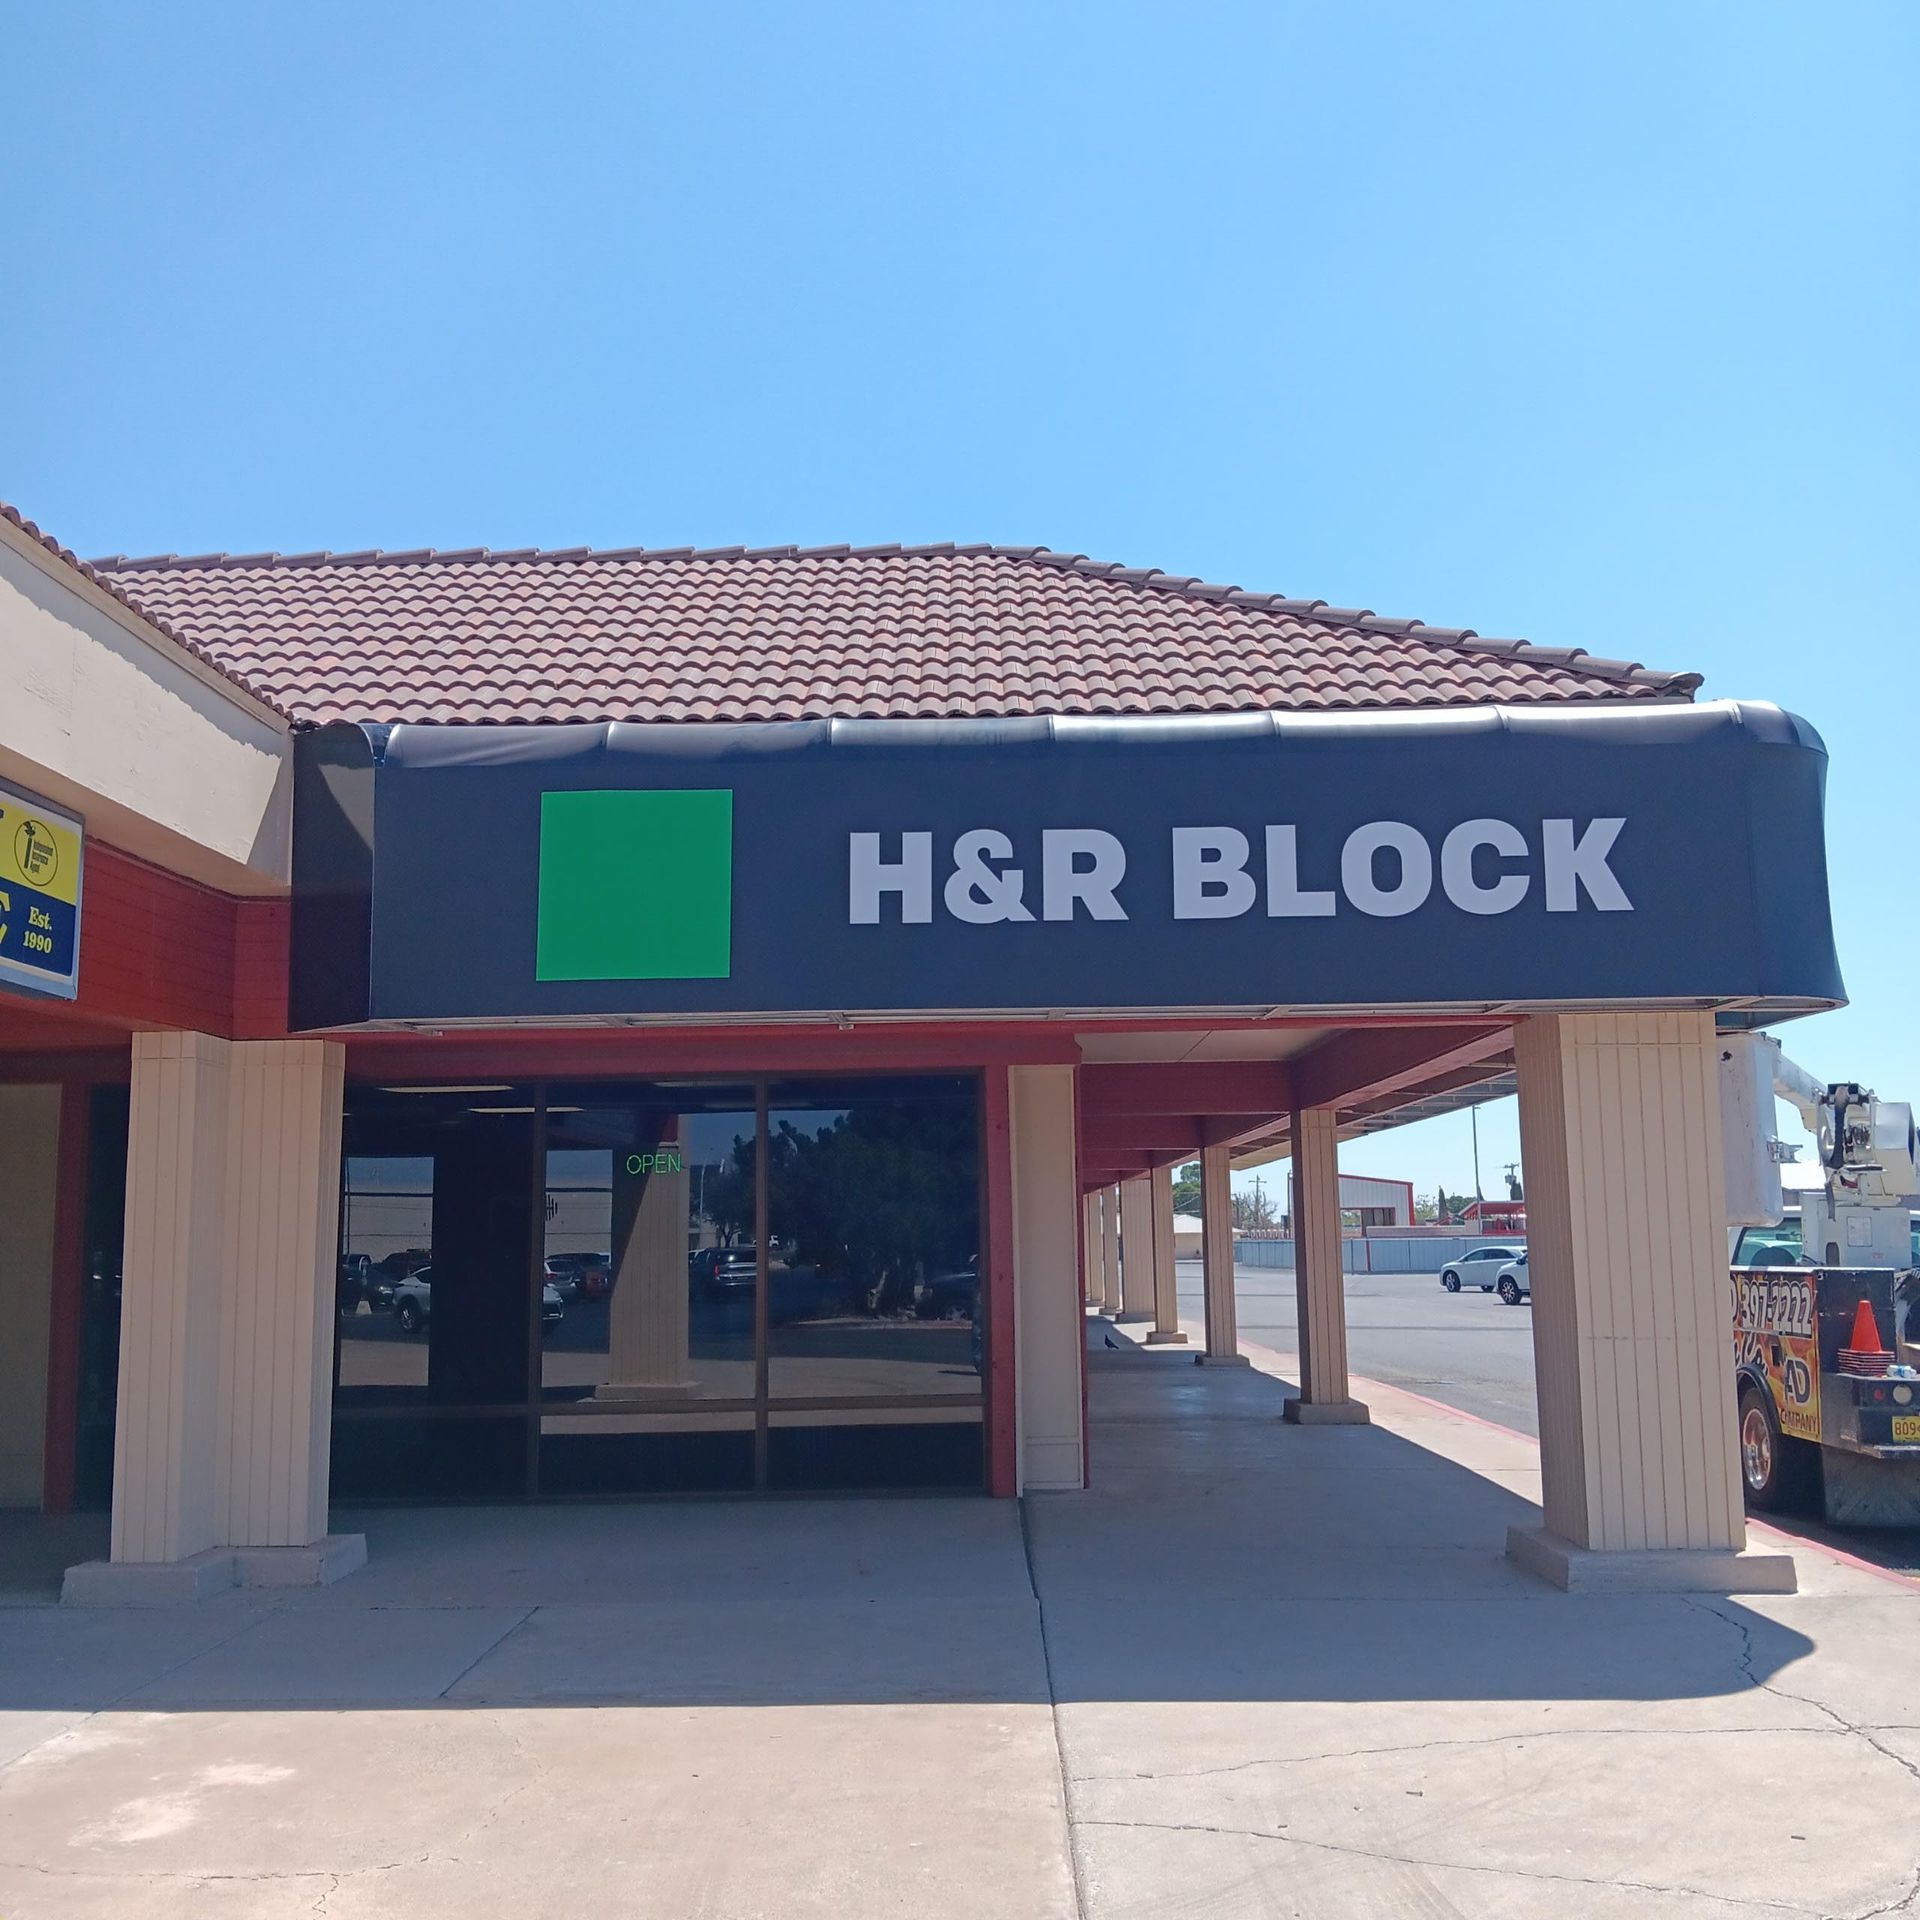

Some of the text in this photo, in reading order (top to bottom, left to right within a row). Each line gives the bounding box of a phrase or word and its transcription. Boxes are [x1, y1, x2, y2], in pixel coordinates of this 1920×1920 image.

[849, 817, 1635, 925] H&R BLOCK
[28, 906, 53, 930] Est.
[23, 931, 53, 954] 1990
[626, 1153, 681, 1175] OPEN
